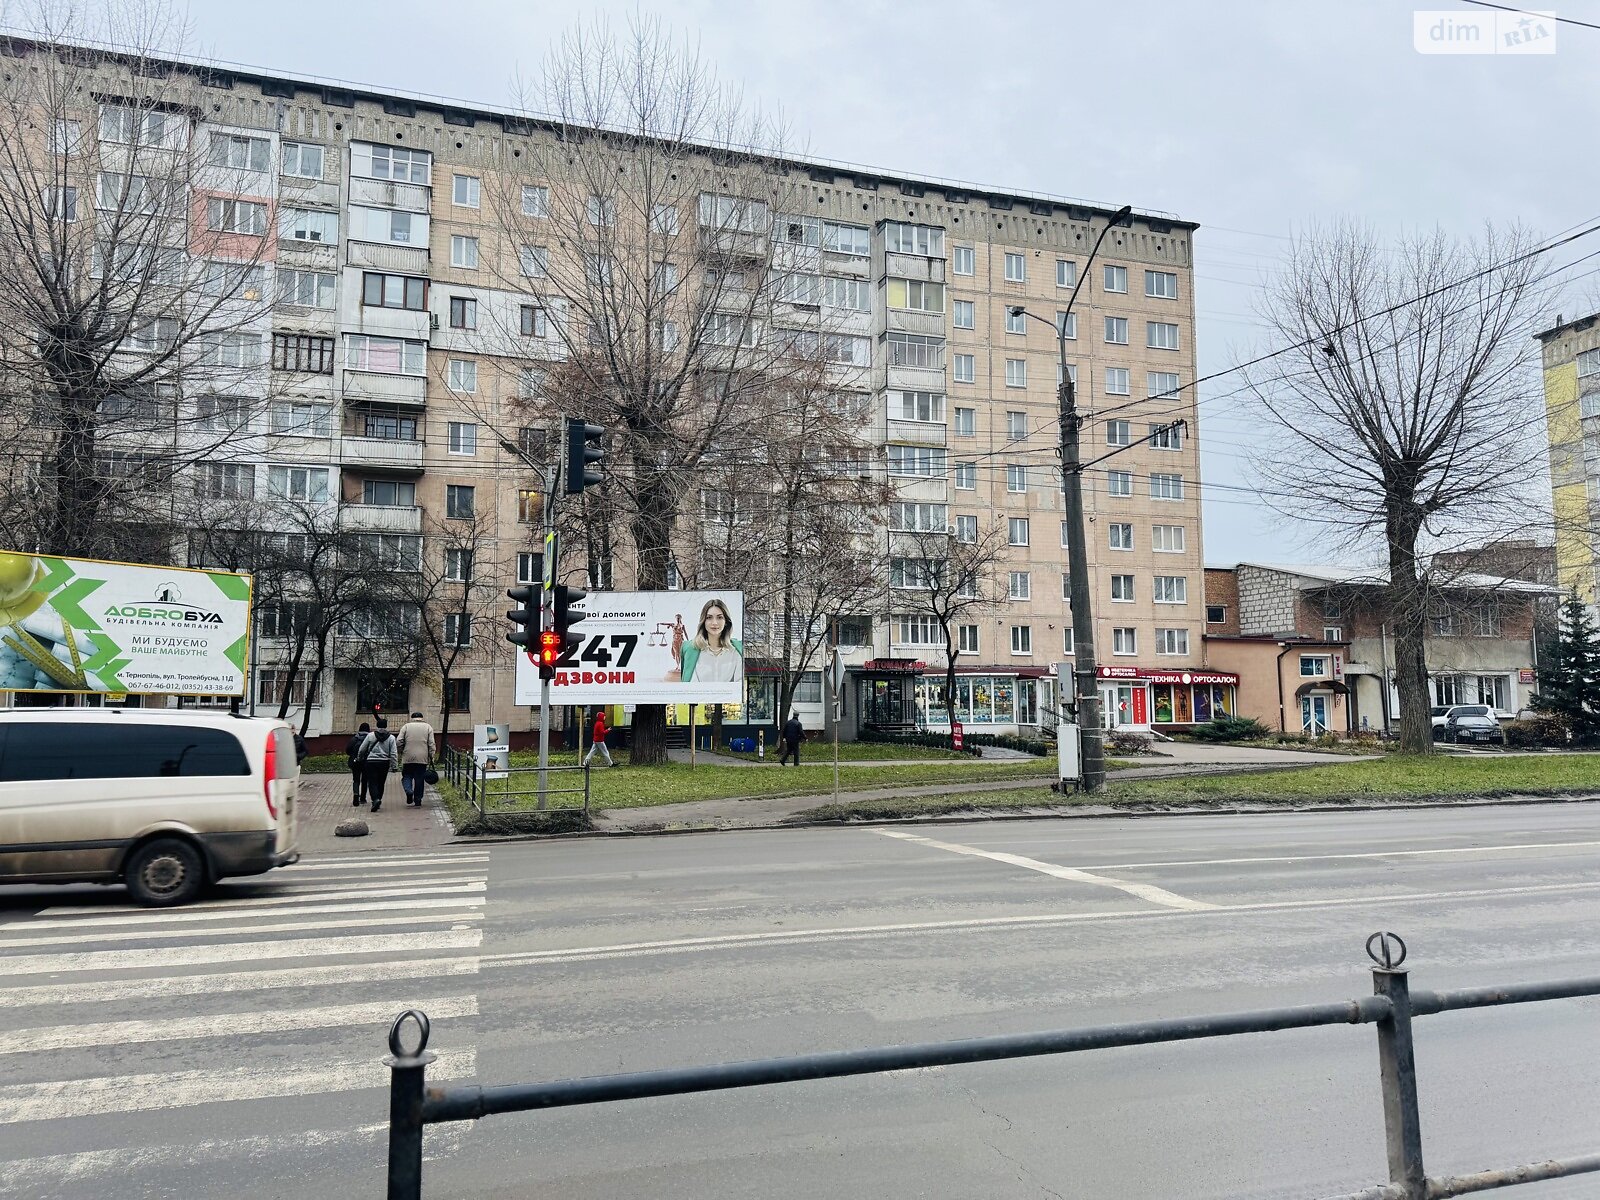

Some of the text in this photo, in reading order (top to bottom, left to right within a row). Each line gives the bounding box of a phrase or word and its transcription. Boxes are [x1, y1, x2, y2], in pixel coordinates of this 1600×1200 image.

[106, 618, 219, 630] БУДІВЕЛЬНА КОМПАНІЯ
[132, 636, 208, 648] МИ БУДУЄМО
[131, 646, 208, 657] ВАШЕ МАЙБУТНЄ
[125, 671, 162, 680] Тернопіль,
[554, 671, 635, 687] ДЗВОНИ
[1193, 676, 1237, 684] ОРТОСАЛОН
[128, 682, 181, 690] 067-67-46-012,
[182, 682, 204, 691] (0352)
